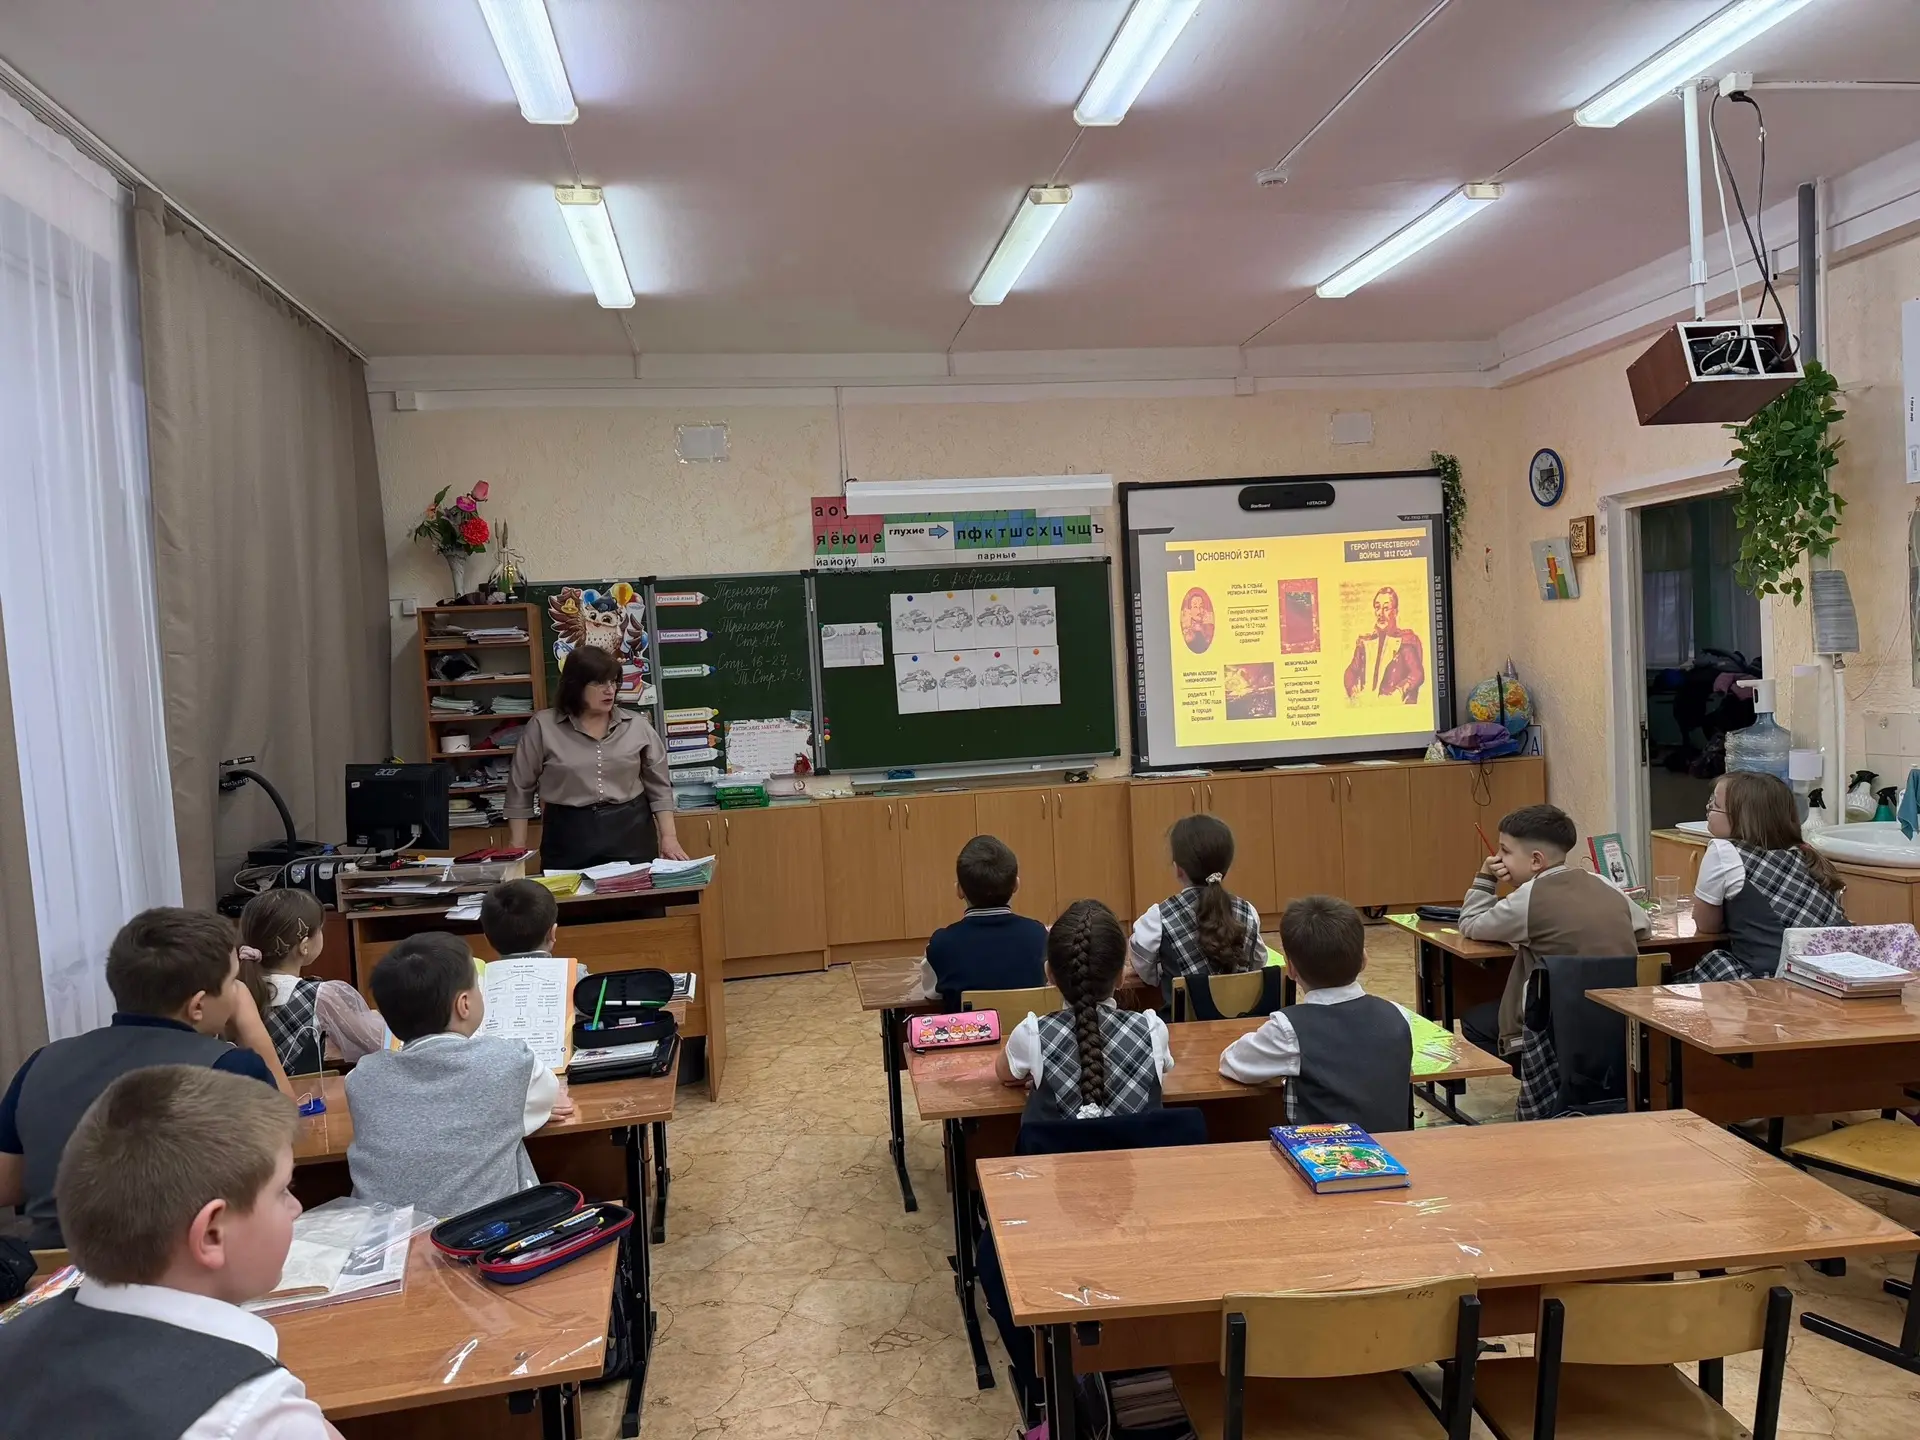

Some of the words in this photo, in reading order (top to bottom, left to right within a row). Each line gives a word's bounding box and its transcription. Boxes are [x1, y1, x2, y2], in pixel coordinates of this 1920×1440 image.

[888, 528, 925, 537] глухие
[1350, 542, 1370, 551] ГЕРОЙ
[1370, 540, 1420, 549] ОТЕЧЕСТВЕННОЙ
[977, 552, 1017, 561] парные
[1178, 555, 1183, 565] 1
[1196, 550, 1242, 562] ОСНОВНОЙ
[1244, 550, 1265, 559] ЭТАП
[1359, 551, 1381, 560] ВОЙНЫ
[1383, 550, 1396, 558] 1812
[1396, 550, 1413, 558] ГОДА
[816, 557, 829, 567] йа
[830, 557, 843, 566] йо
[844, 556, 857, 567] йу
[873, 555, 886, 565] йэ
[375, 767, 402, 776] acer
